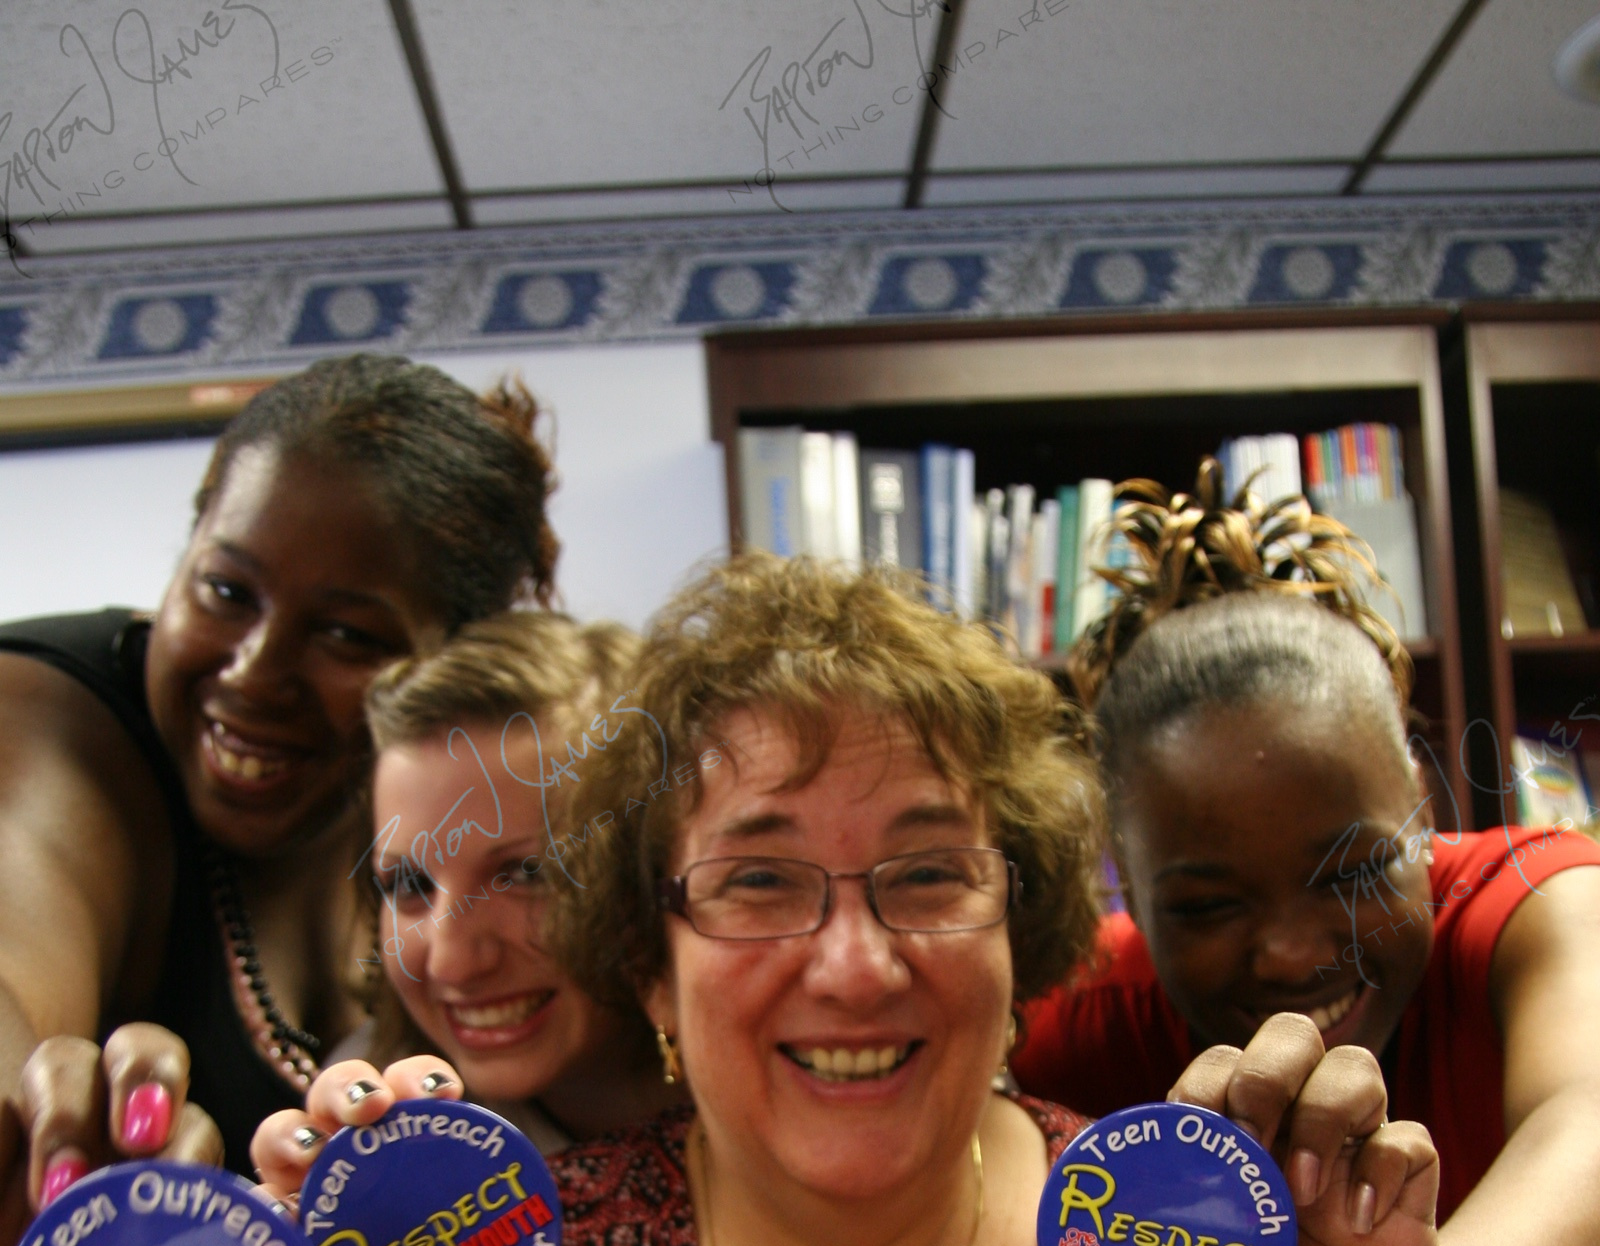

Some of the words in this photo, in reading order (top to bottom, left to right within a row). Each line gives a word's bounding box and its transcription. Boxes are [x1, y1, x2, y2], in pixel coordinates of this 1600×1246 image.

[304, 1159, 357, 1237] Teen
[352, 1111, 506, 1158] Outreach
[1079, 1119, 1161, 1162] Teen
[1175, 1114, 1290, 1236] Outreach
